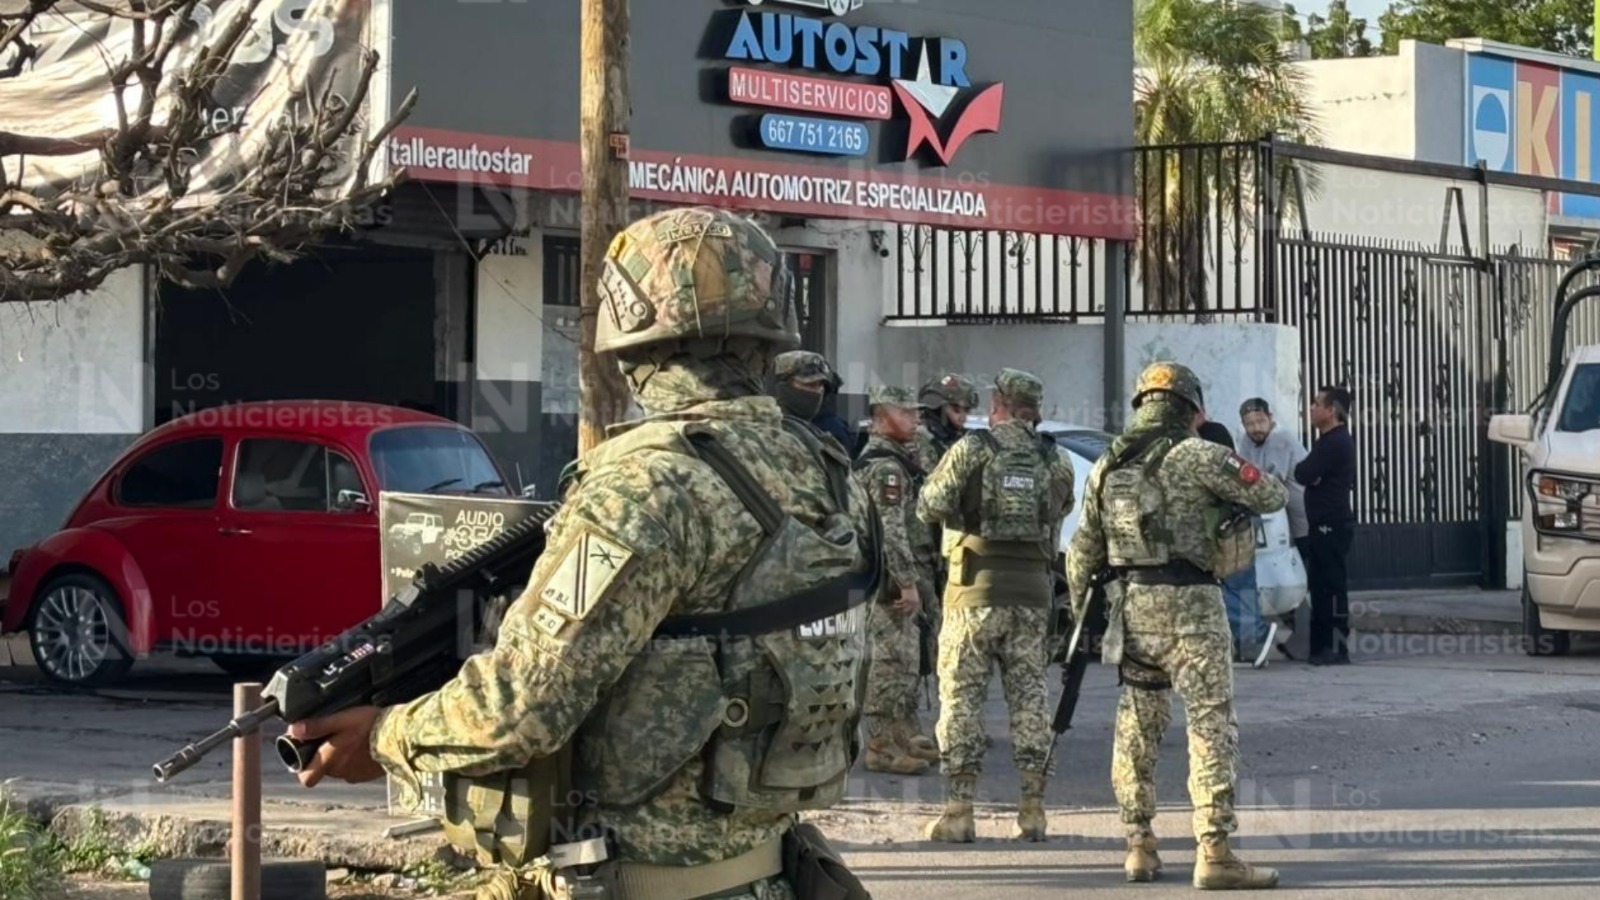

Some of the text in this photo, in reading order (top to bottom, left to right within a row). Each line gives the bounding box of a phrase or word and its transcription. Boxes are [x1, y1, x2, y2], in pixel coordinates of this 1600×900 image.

[731, 72, 889, 116] MULTISERVICIOS
[768, 118, 862, 150] 667 751 2165
[390, 136, 533, 175] tallerautostar
[629, 157, 987, 218] MECÁNICA AUTOMOTRIZ ESPECIALIZADA
[456, 509, 505, 527] AUDIO
